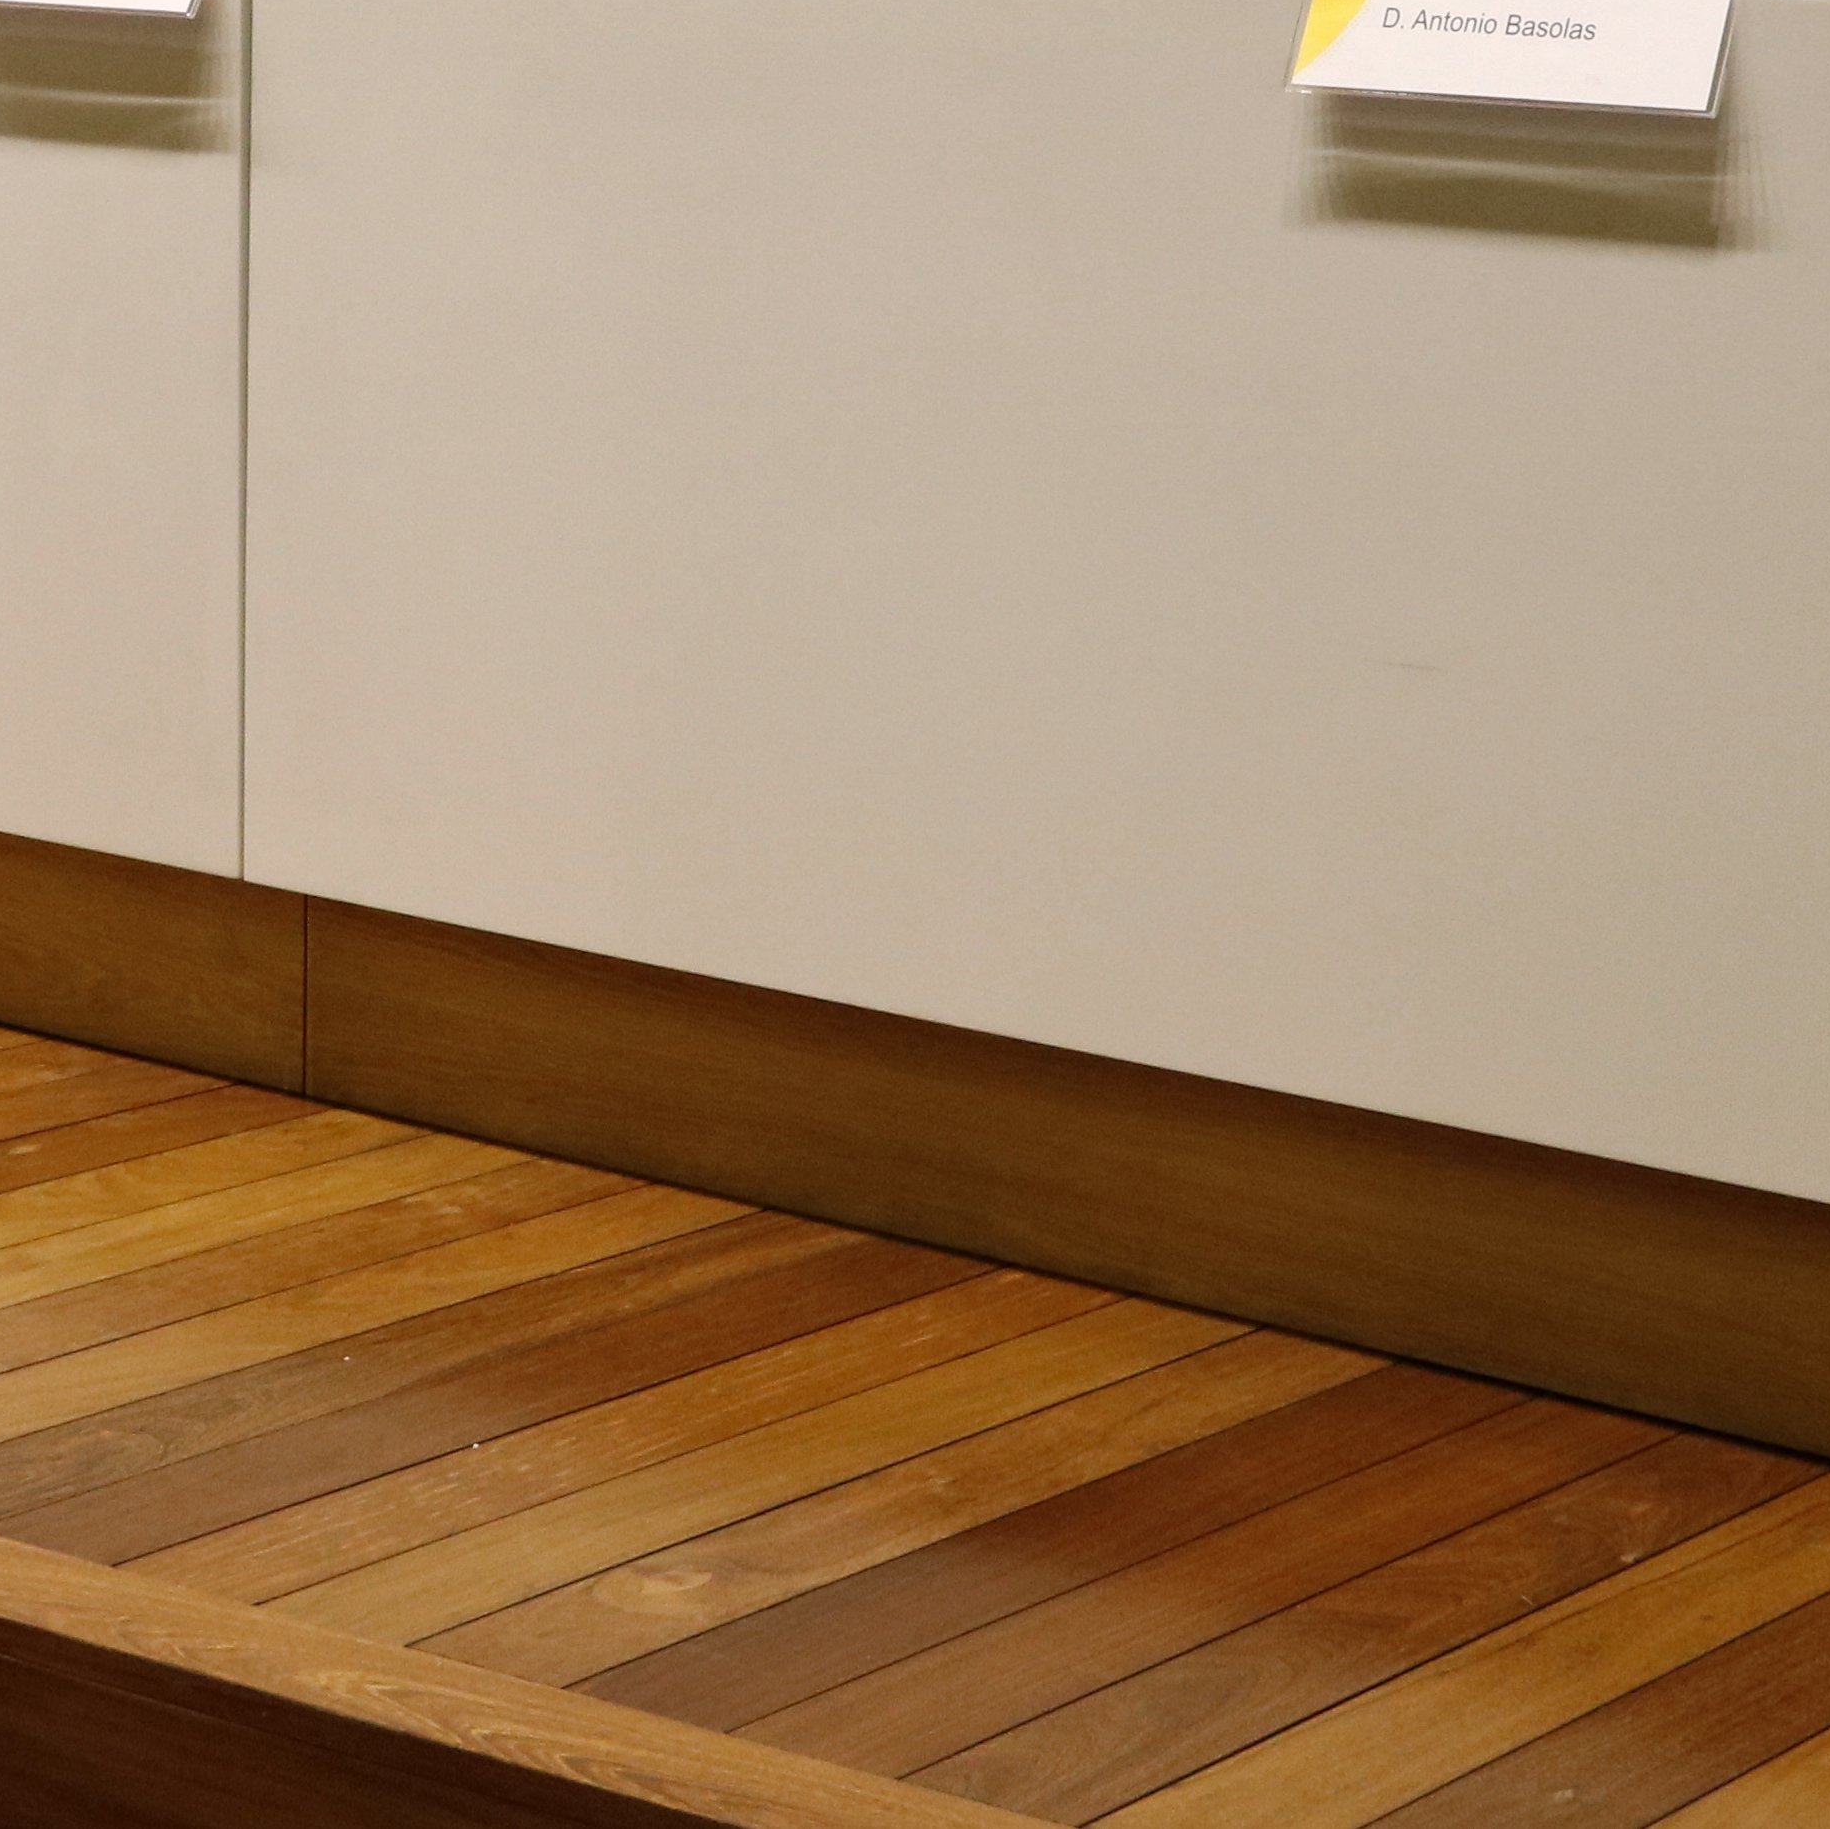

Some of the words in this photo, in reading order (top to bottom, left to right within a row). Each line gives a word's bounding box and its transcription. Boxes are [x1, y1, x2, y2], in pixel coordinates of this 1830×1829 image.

[1382, 6, 1404, 30] D.
[1411, 8, 1498, 35] Antonio
[1504, 14, 1597, 42] Basolas
